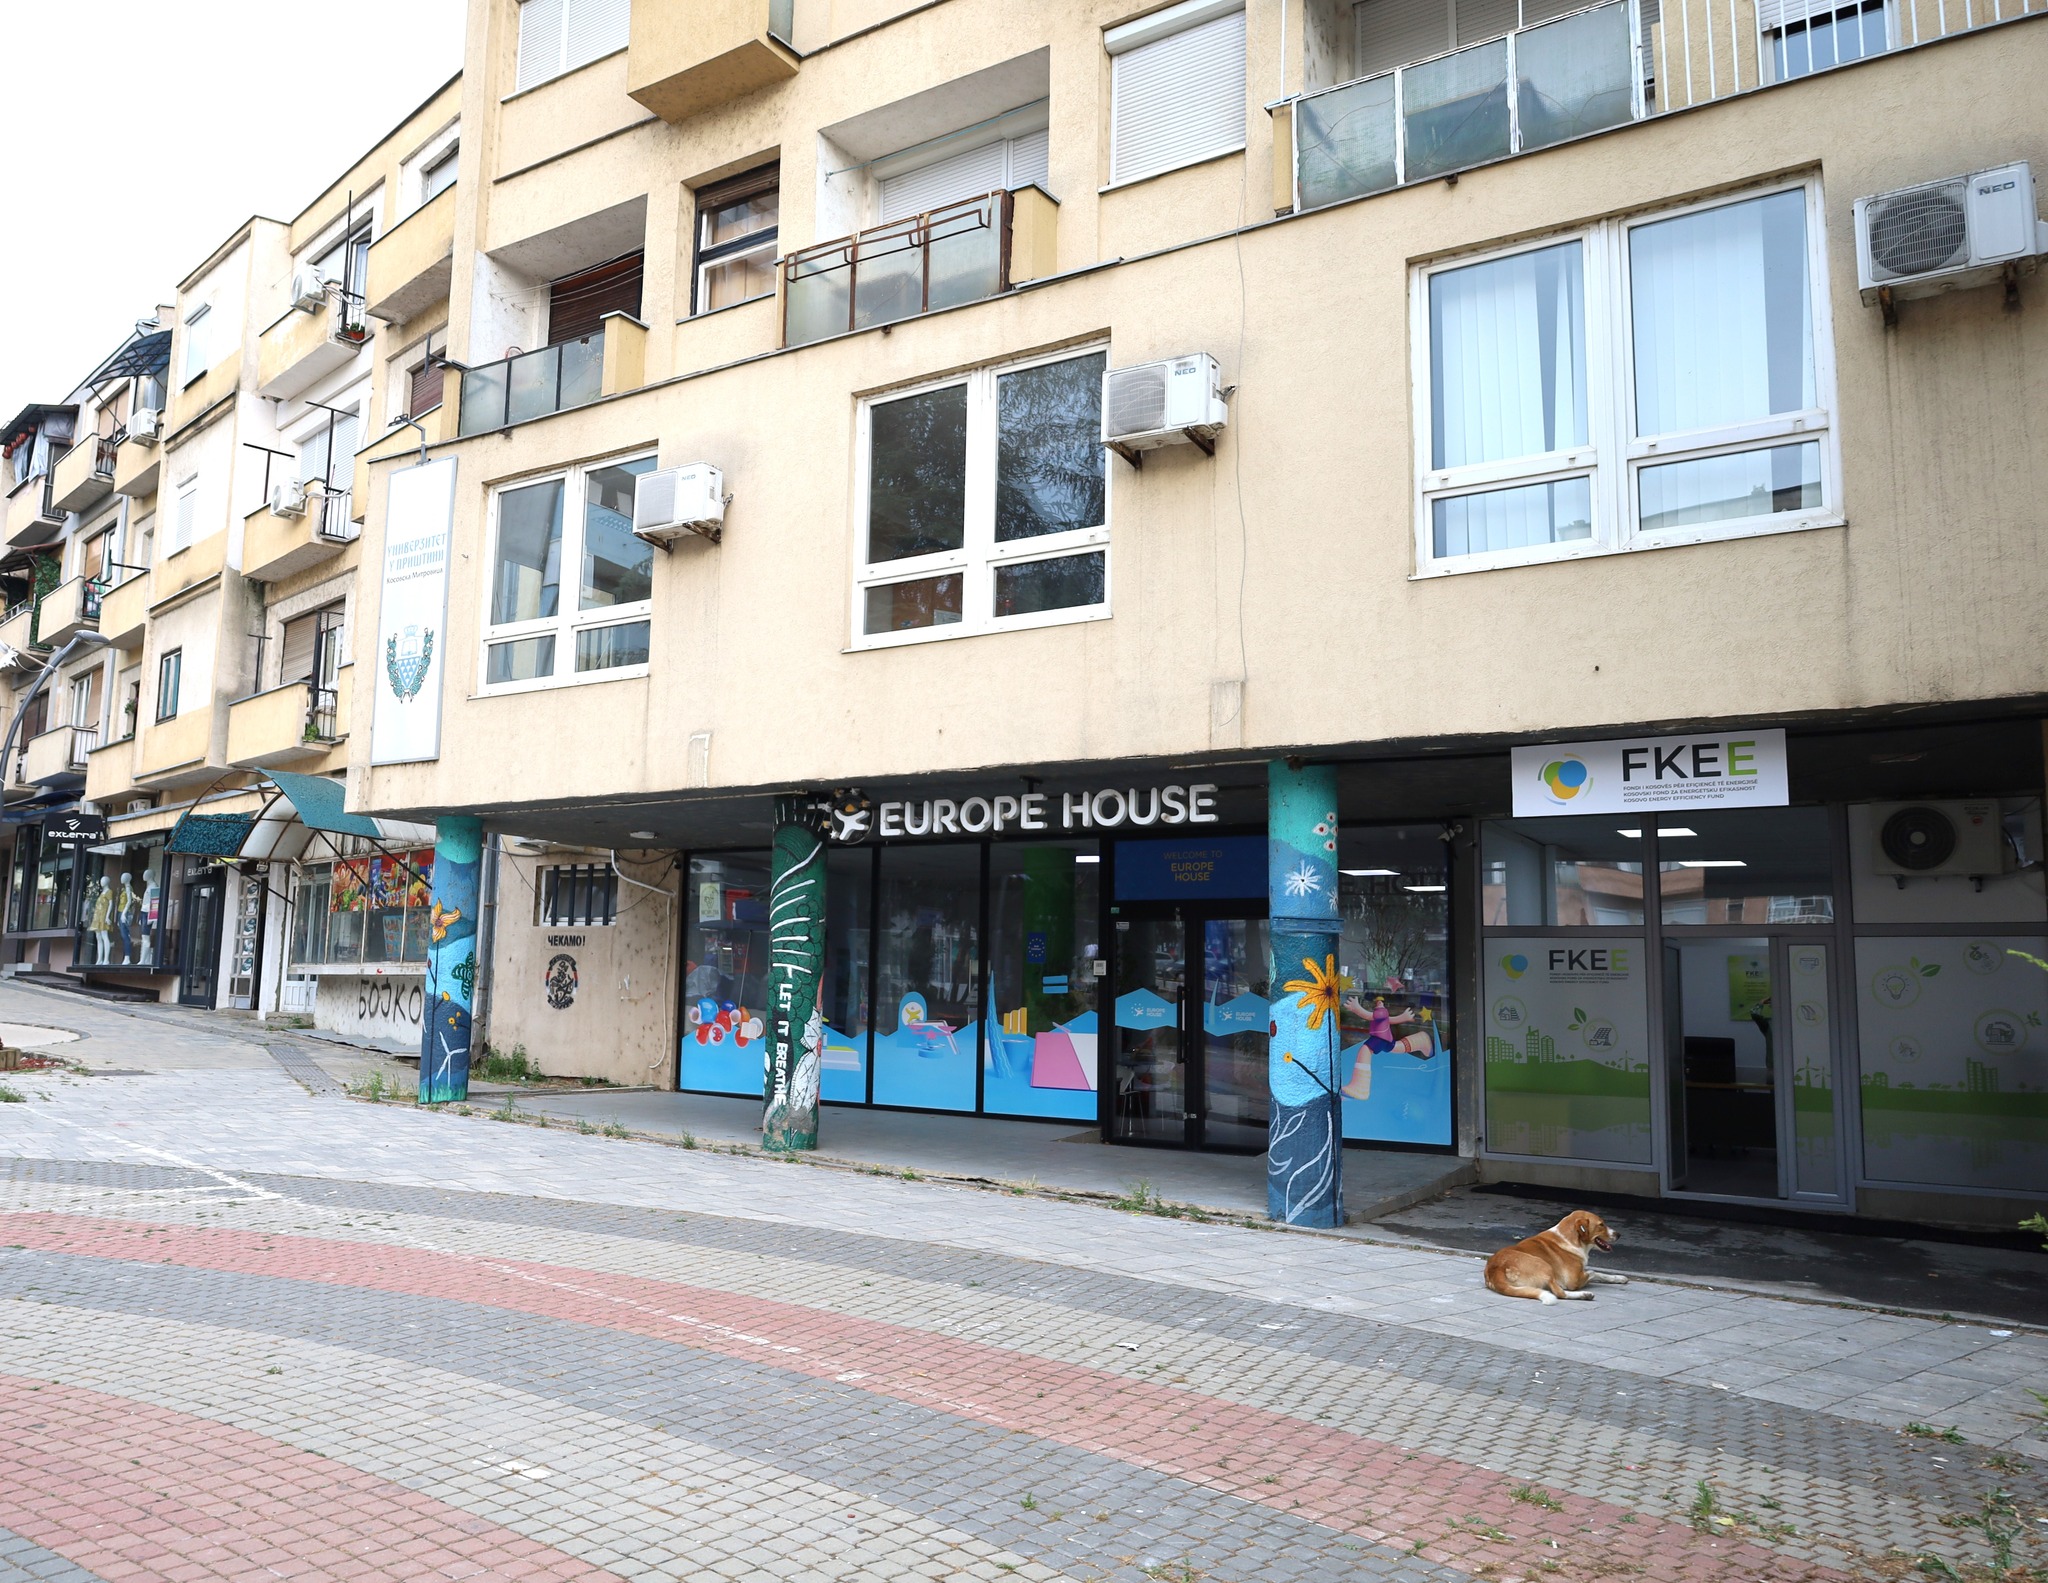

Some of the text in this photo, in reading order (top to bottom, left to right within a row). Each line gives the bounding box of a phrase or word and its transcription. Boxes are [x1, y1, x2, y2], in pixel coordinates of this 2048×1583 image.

[1979, 181, 2016, 196] NEO
[1174, 367, 1197, 376] NEO
[1622, 740, 1758, 781] FKEE
[880, 784, 1219, 836] EUROPE HOUSE
[1163, 850, 1222, 860] WELCOME TO
[1171, 862, 1214, 872] EUROPE
[1174, 872, 1210, 882] HOUSE
[548, 935, 586, 946] ЧЕКАМО!
[1549, 949, 1629, 971] FKEE
[774, 983, 793, 1106] LET IT BREATHE
